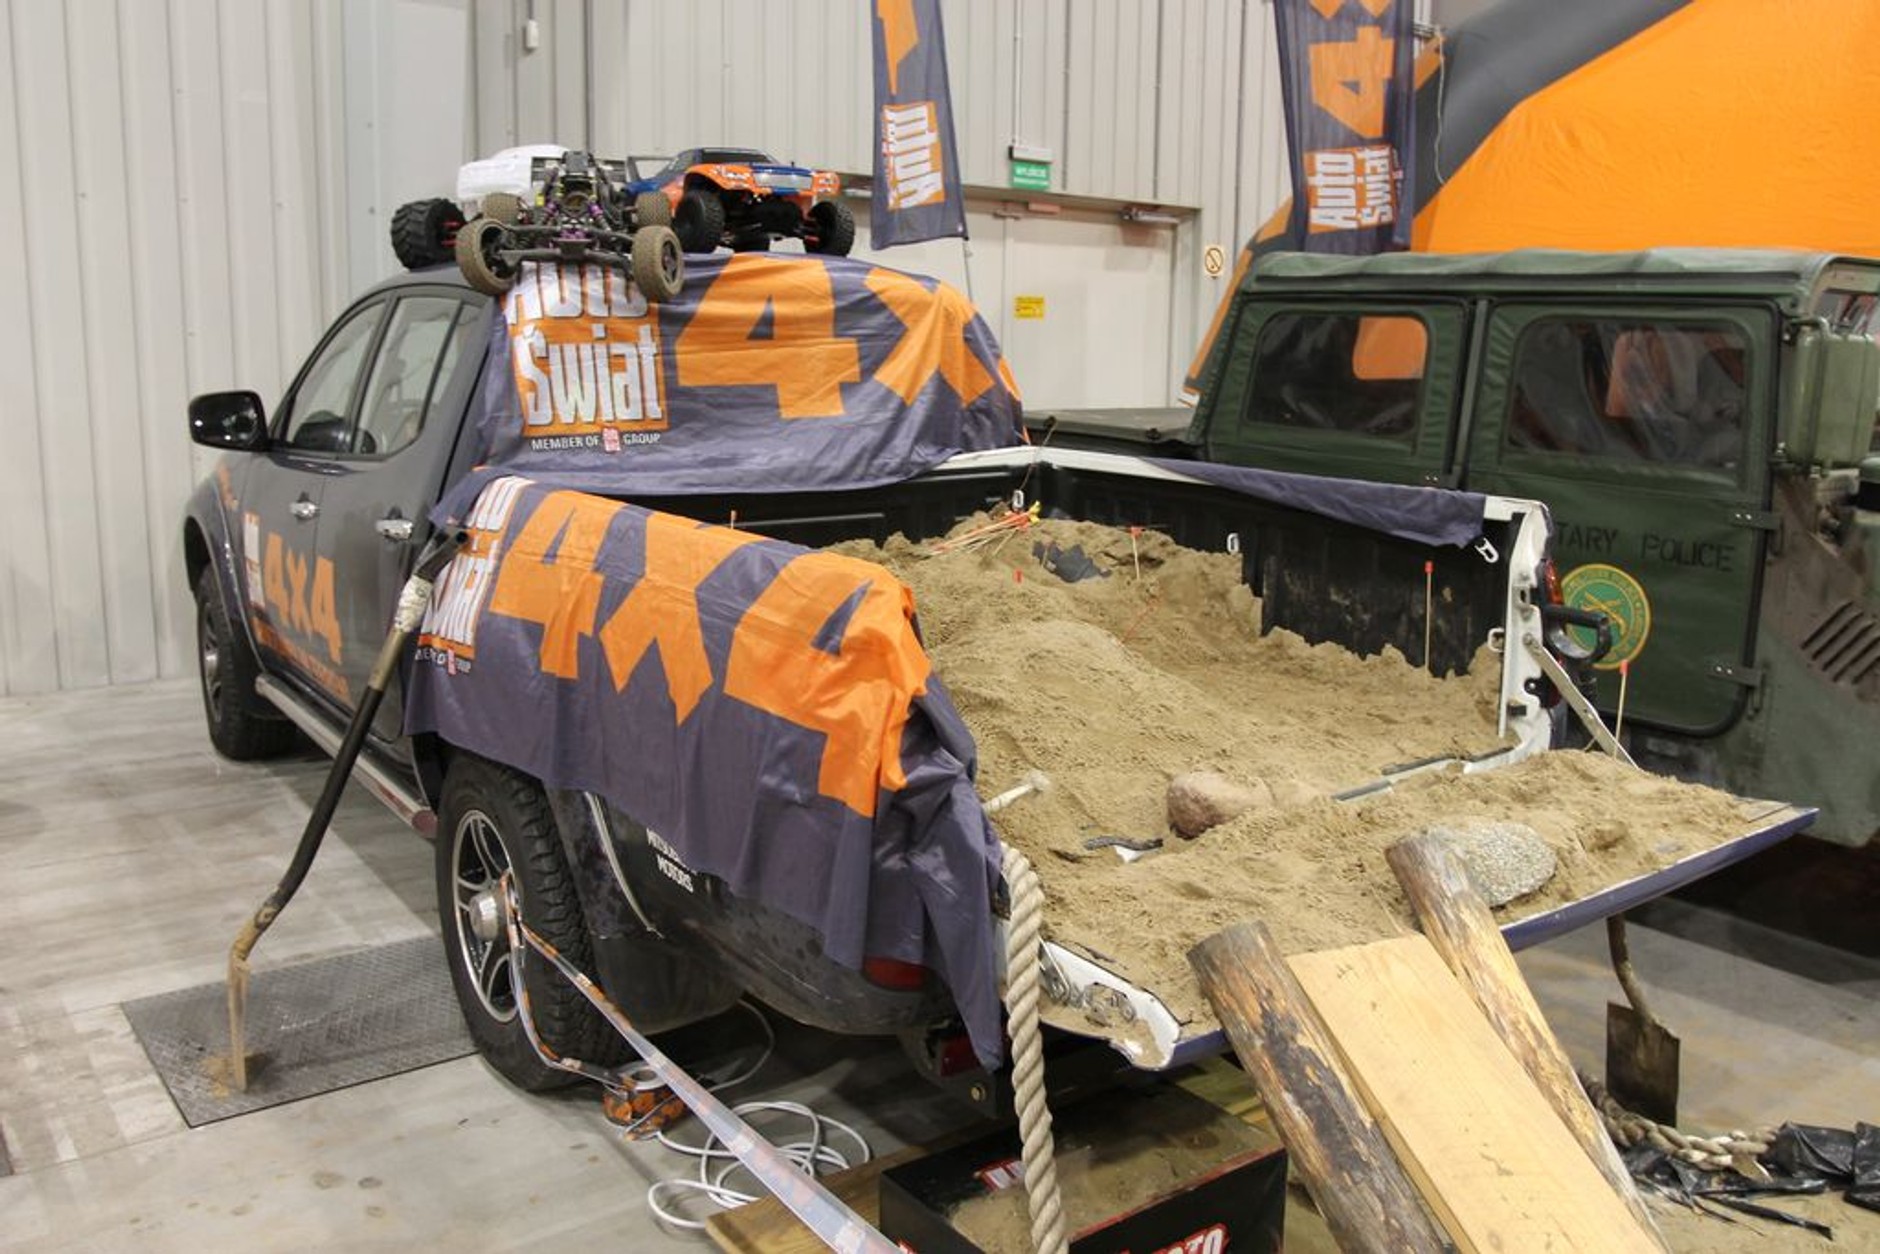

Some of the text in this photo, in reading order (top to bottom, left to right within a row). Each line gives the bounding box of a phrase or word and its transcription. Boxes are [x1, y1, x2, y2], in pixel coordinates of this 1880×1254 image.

[1308, 152, 1359, 229] Auto
[531, 435, 583, 451] MEMBER
[585, 435, 600, 447] OF
[622, 432, 661, 446] GROUP
[1640, 530, 1736, 573] POLICE
